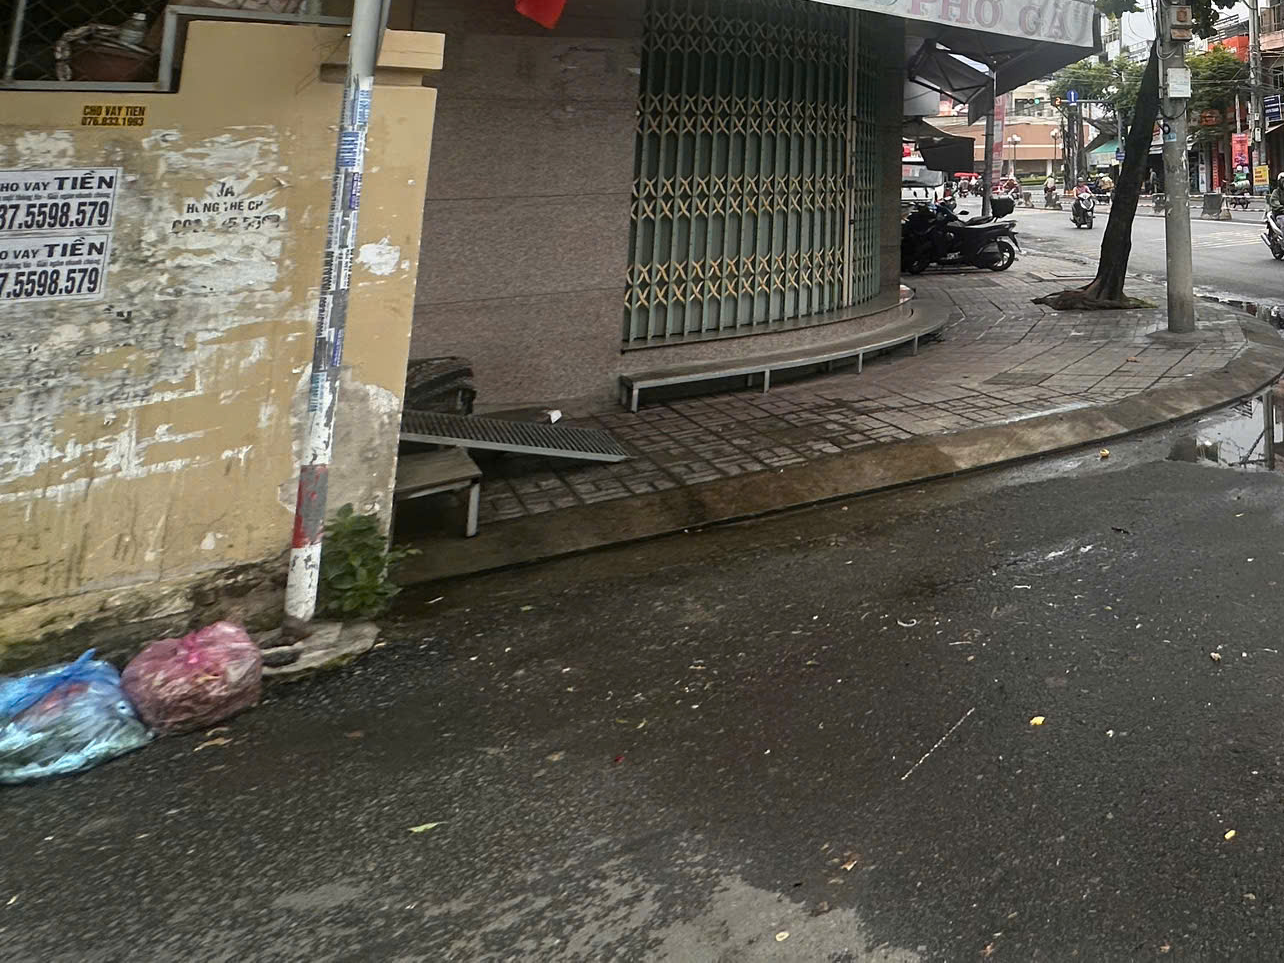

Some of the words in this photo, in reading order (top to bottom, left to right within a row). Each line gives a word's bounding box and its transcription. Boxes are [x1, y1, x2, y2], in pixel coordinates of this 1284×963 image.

[105, 105, 123, 116] VAY
[24, 181, 50, 191] VAY
[54, 170, 114, 191] TIỀN
[13, 248, 39, 259] VAY
[43, 237, 105, 258] TIỀN
[0, 267, 99, 298] 7.5598.579
